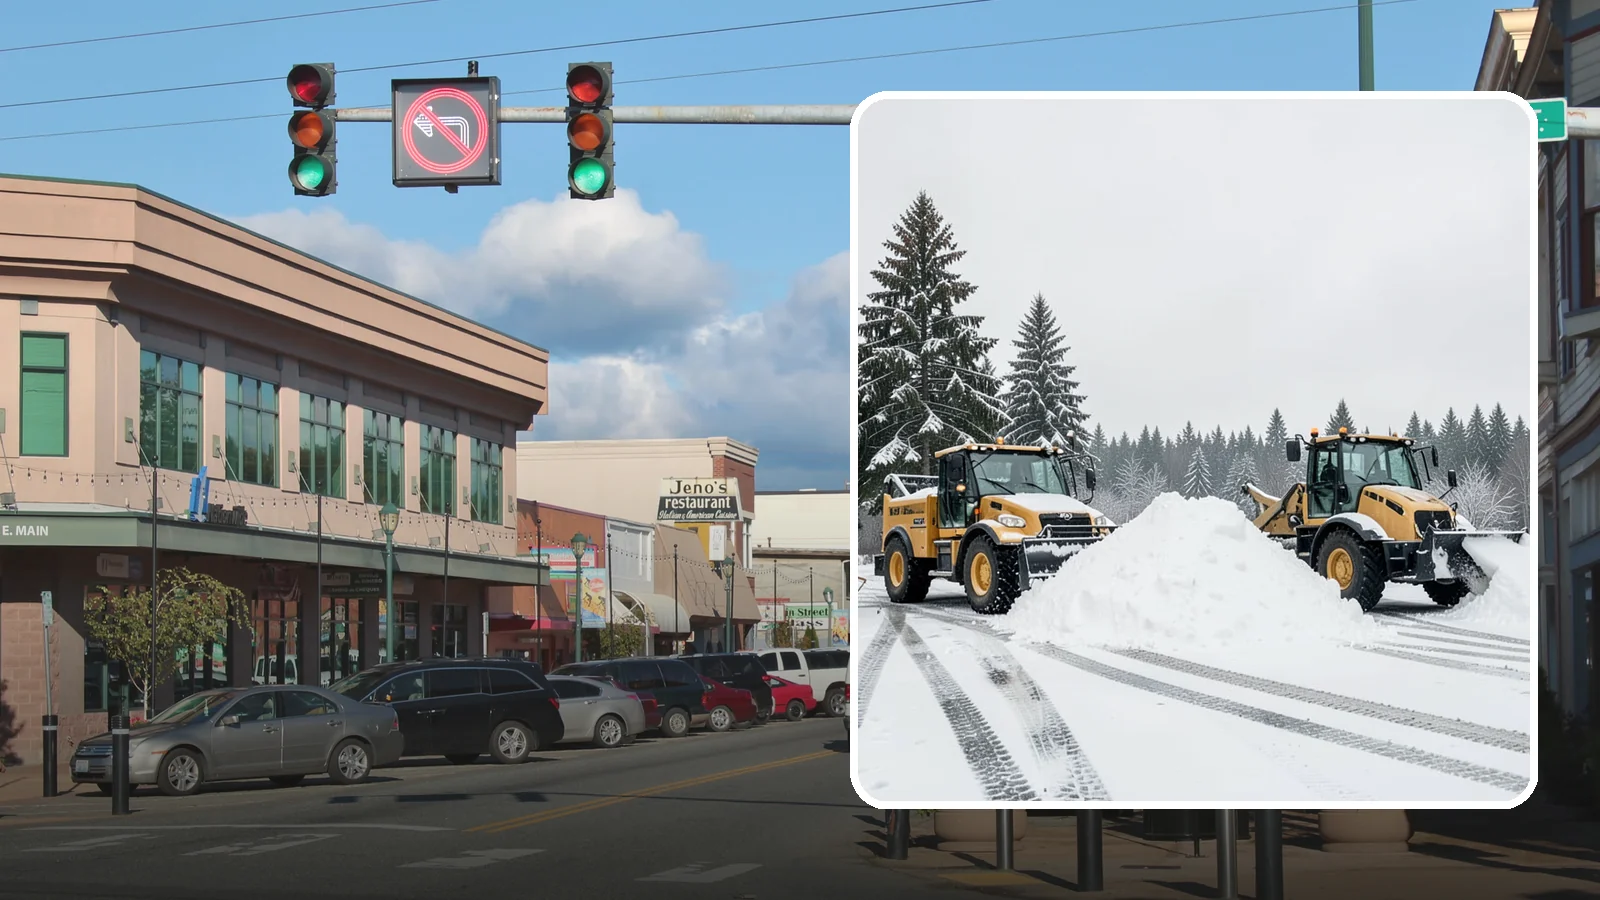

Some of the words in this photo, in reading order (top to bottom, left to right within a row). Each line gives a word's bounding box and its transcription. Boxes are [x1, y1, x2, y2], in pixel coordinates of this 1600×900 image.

[669, 480, 728, 495] Jeno's
[665, 496, 731, 509] restaurant
[658, 509, 681, 519] Italian
[686, 509, 715, 519] American
[715, 509, 737, 519] Cuisine
[2, 525, 13, 536] E.
[15, 525, 49, 536] MAIN
[797, 607, 829, 617] Street
[791, 619, 823, 627] lass
